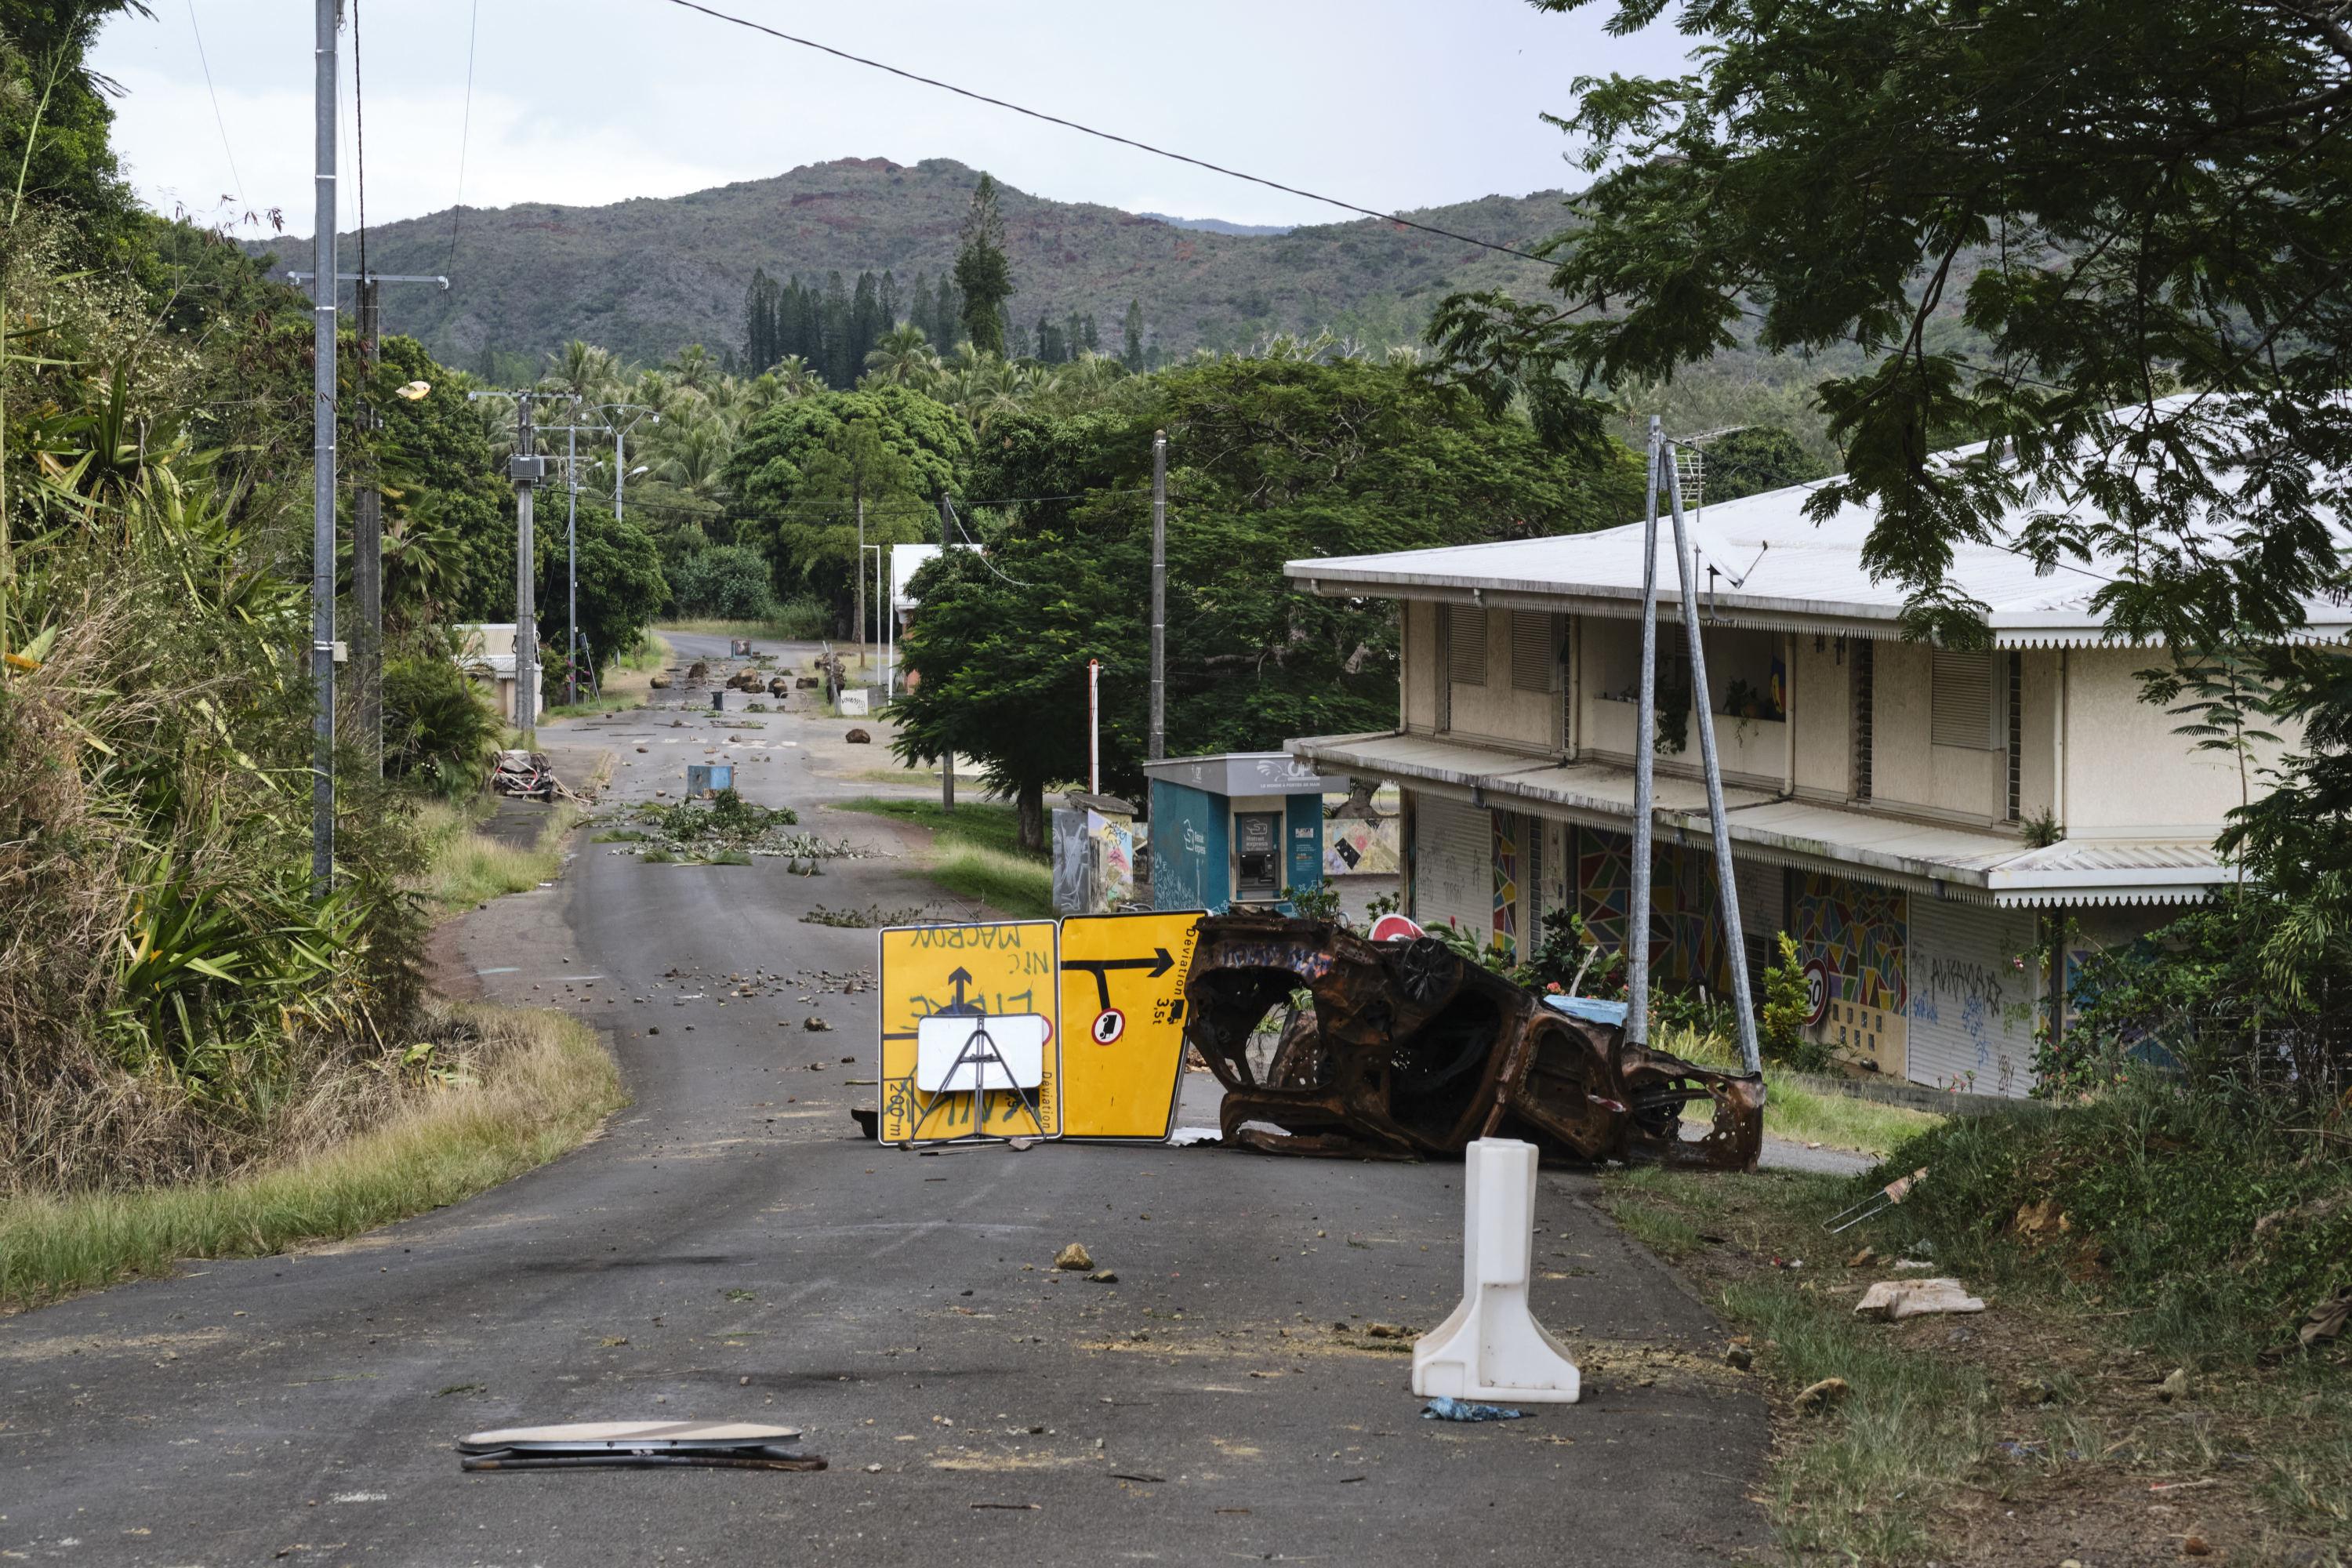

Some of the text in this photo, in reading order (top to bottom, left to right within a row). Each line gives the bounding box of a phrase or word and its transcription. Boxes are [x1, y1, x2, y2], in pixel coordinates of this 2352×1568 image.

[1287, 760, 1318, 777] OP
[910, 924, 1022, 949] MACRON
[1174, 928, 1196, 996] Déviation
[889, 1083, 906, 1137] 200 m
[1041, 1071, 1052, 1129] Déviation
